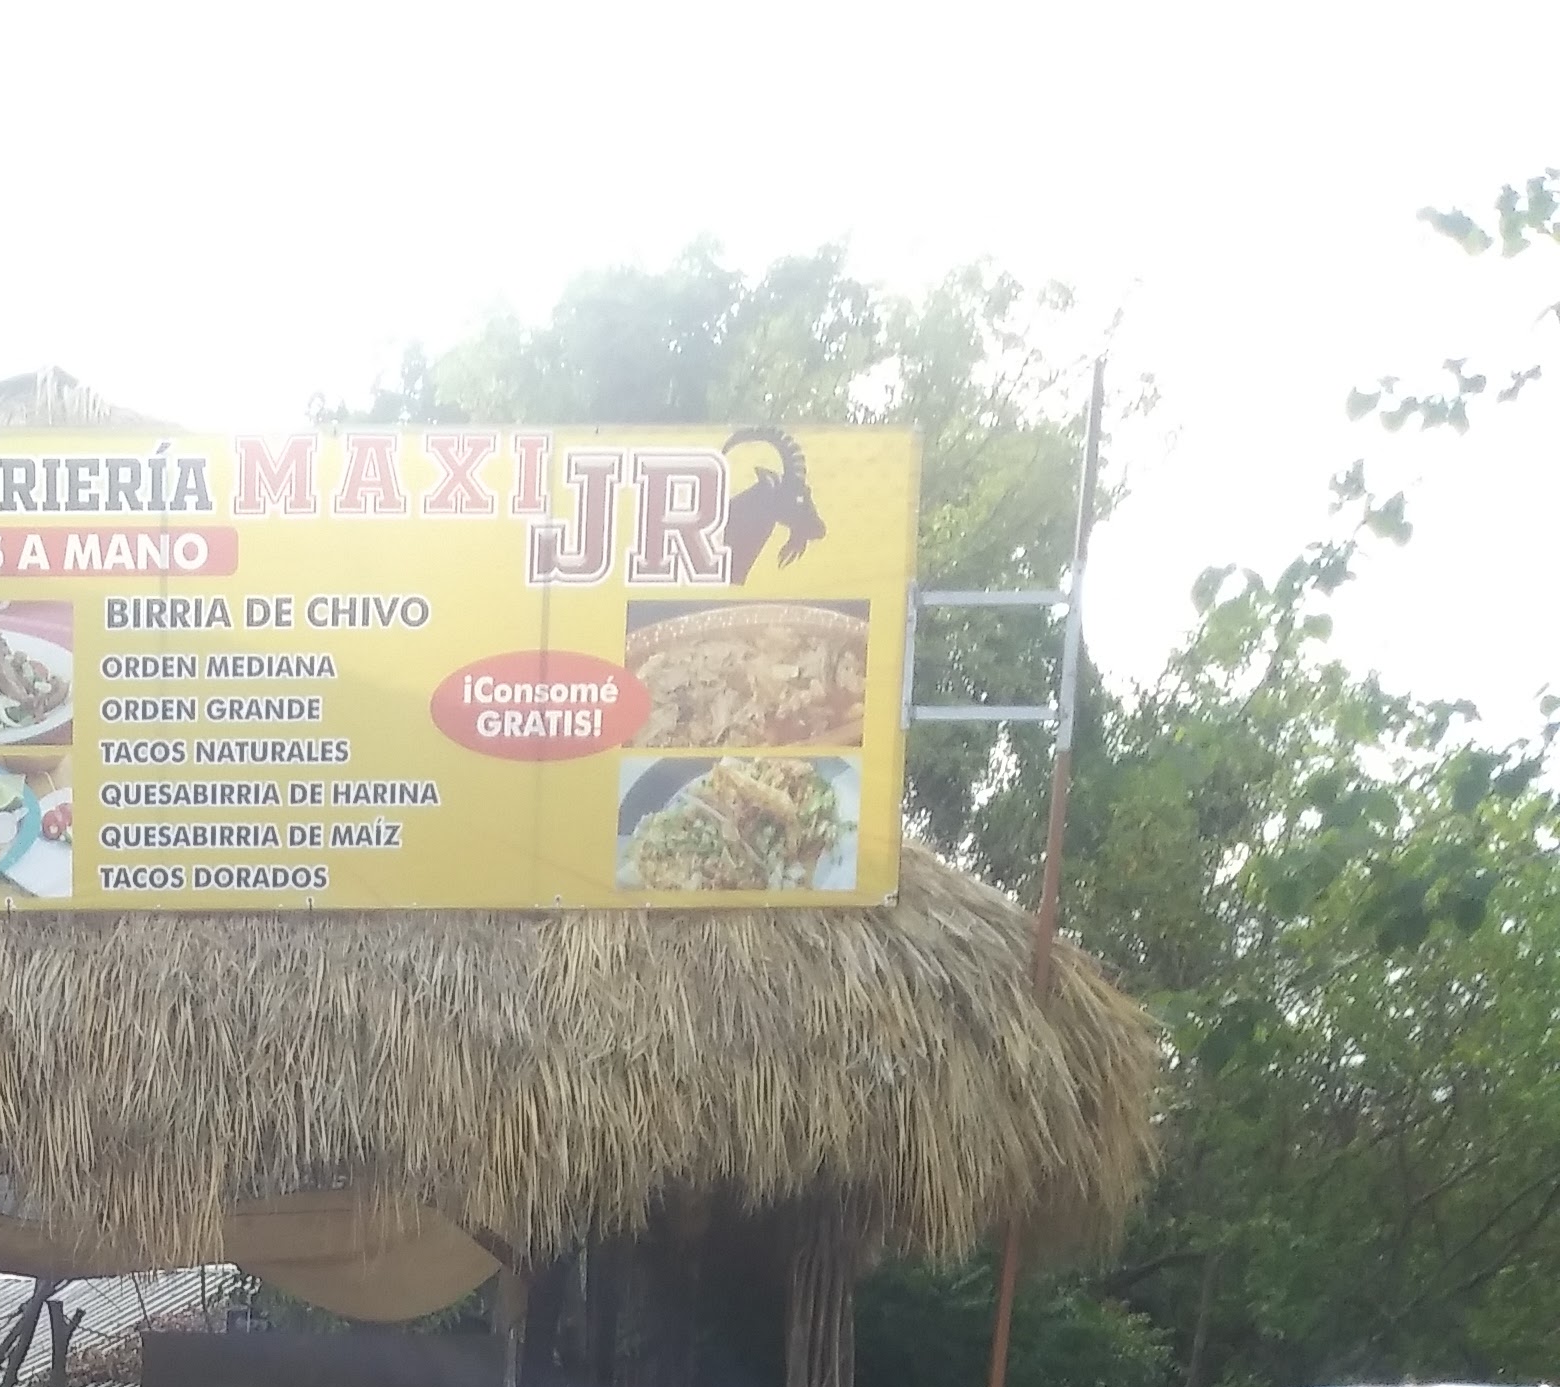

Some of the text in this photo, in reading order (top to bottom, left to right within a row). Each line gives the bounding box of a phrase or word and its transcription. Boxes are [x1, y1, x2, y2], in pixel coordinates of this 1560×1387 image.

[233, 433, 734, 585] MAXI JR
[17, 533, 50, 571] A
[63, 532, 210, 571] MANO
[105, 596, 430, 628] BIRRIA DE CHIVO
[101, 654, 337, 679] ORDEN MEDIANA
[101, 697, 321, 721] ORDEN GRANDE
[475, 709, 603, 738] GRATIS!
[100, 740, 350, 763] TACOS NATURALES
[100, 782, 440, 807] QUESABIRRIA DE HARINA
[100, 817, 402, 849] QUESABIRRIA DE MAÍZ
[99, 866, 328, 889] TACOS DORADOS
